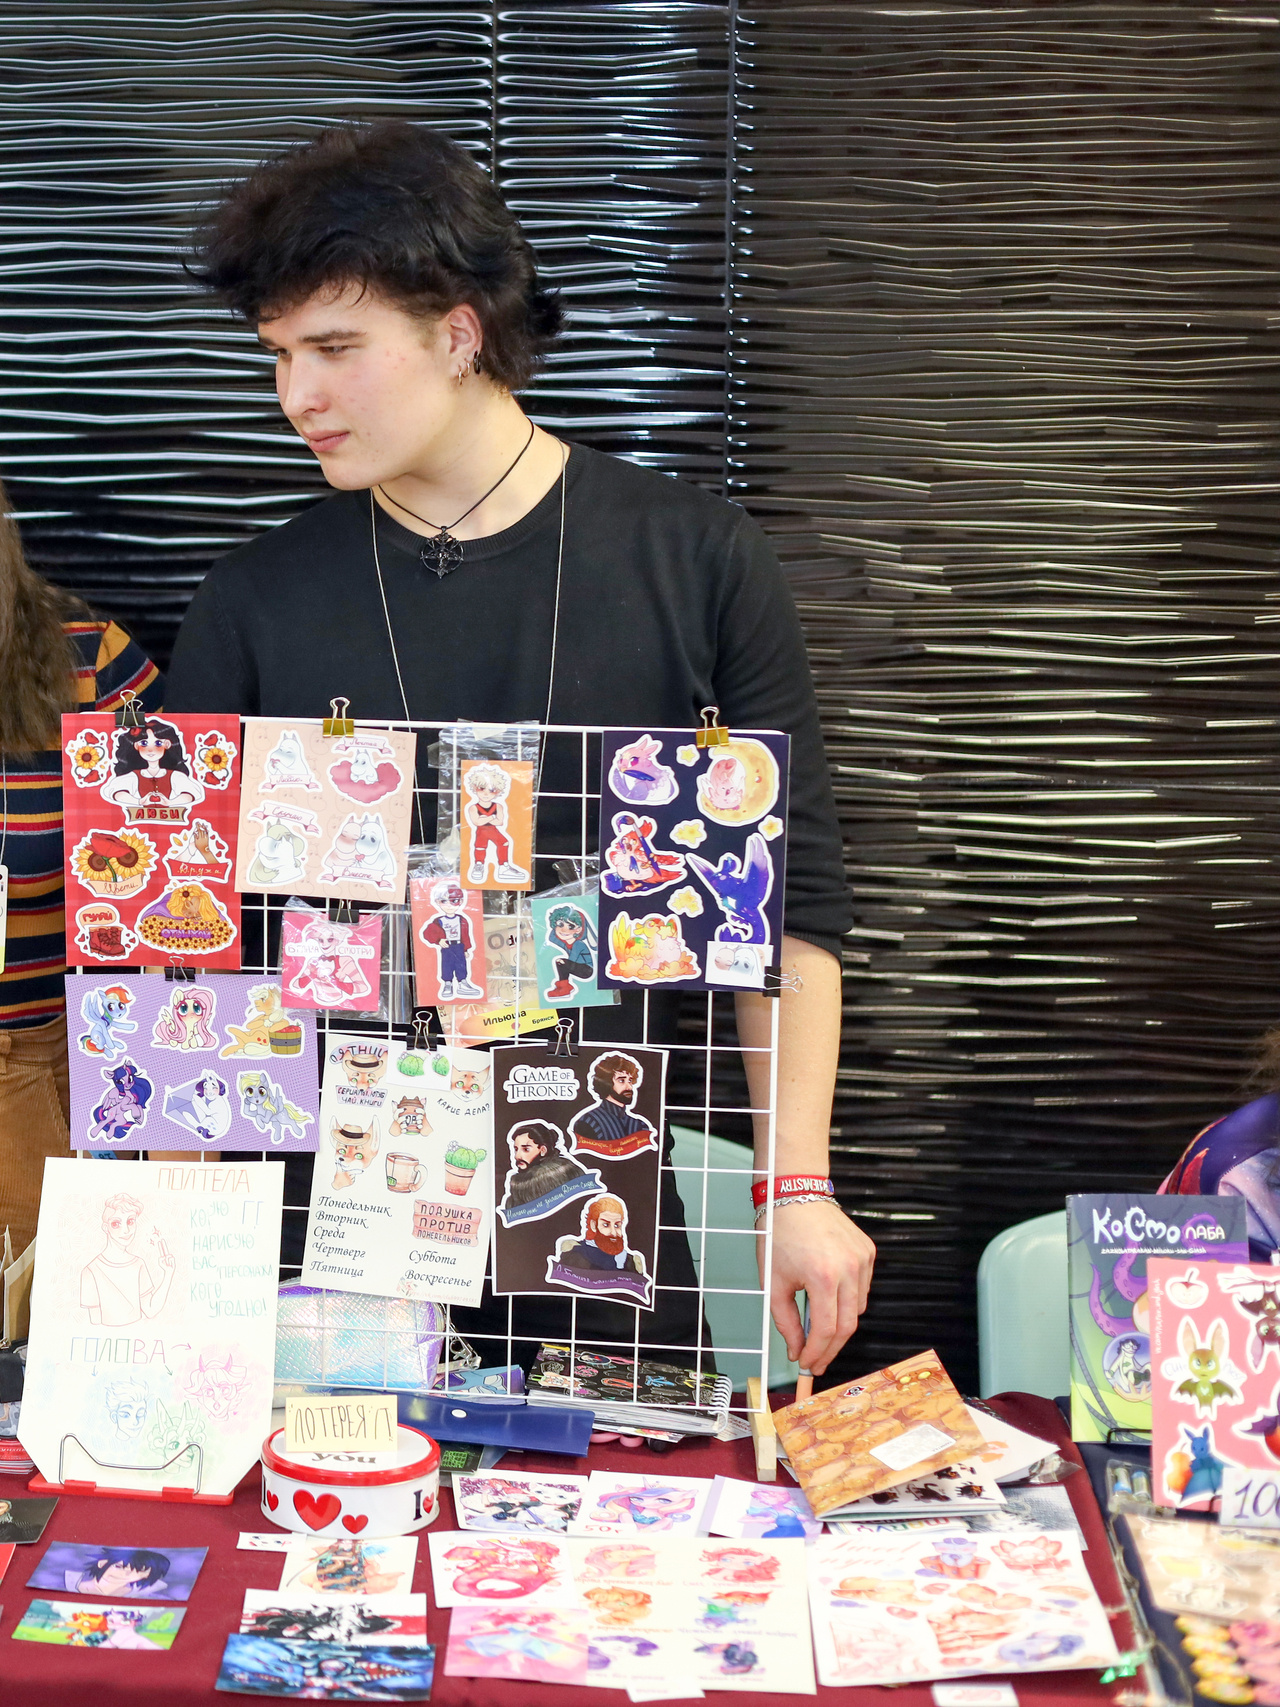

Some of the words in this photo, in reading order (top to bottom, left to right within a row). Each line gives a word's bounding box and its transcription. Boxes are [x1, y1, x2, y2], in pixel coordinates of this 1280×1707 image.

[135, 809, 180, 819] ЛЮБИ
[513, 1068, 558, 1084] GAME
[559, 1072, 571, 1080] OF
[509, 1083, 574, 1099] THRONES
[464, 1102, 491, 1116] ДЕЛА?
[157, 1167, 250, 1193] ПОЛТЕЛА
[317, 1196, 392, 1218] Понедельник
[420, 1204, 473, 1220] ПОДУШКА
[315, 1211, 369, 1229] Вторник
[419, 1217, 471, 1234] ПРОТИВ
[313, 1226, 345, 1241] Среда
[192, 1233, 255, 1252] НАРИСУЮ
[408, 1250, 457, 1265] Суббота
[309, 1261, 364, 1278] Пятница
[404, 1269, 472, 1287] Воскресенье
[190, 1282, 222, 1302] КОГО
[208, 1298, 268, 1318] УГОДНО!
[70, 1337, 166, 1364] ГОЛОВА
[312, 1451, 376, 1464] you
[412, 1489, 423, 1522] I
